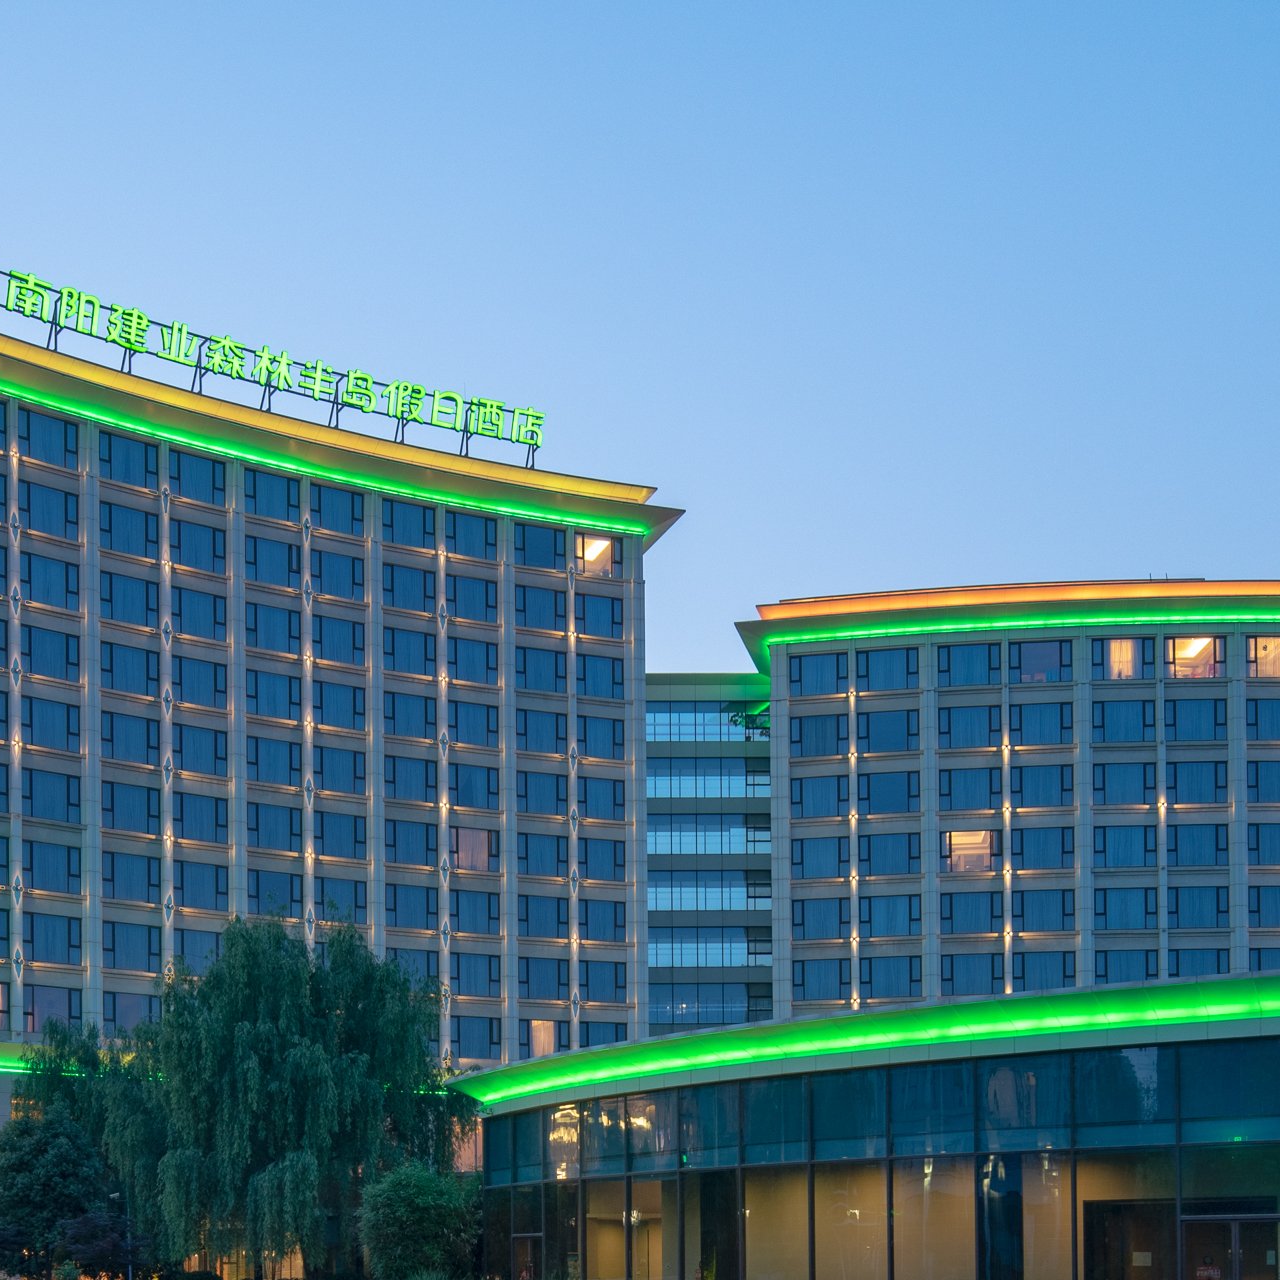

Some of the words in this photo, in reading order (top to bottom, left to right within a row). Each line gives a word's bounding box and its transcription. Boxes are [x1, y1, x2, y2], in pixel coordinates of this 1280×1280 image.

[5, 269, 546, 449] 南阳建业森林半岛假日酒店
